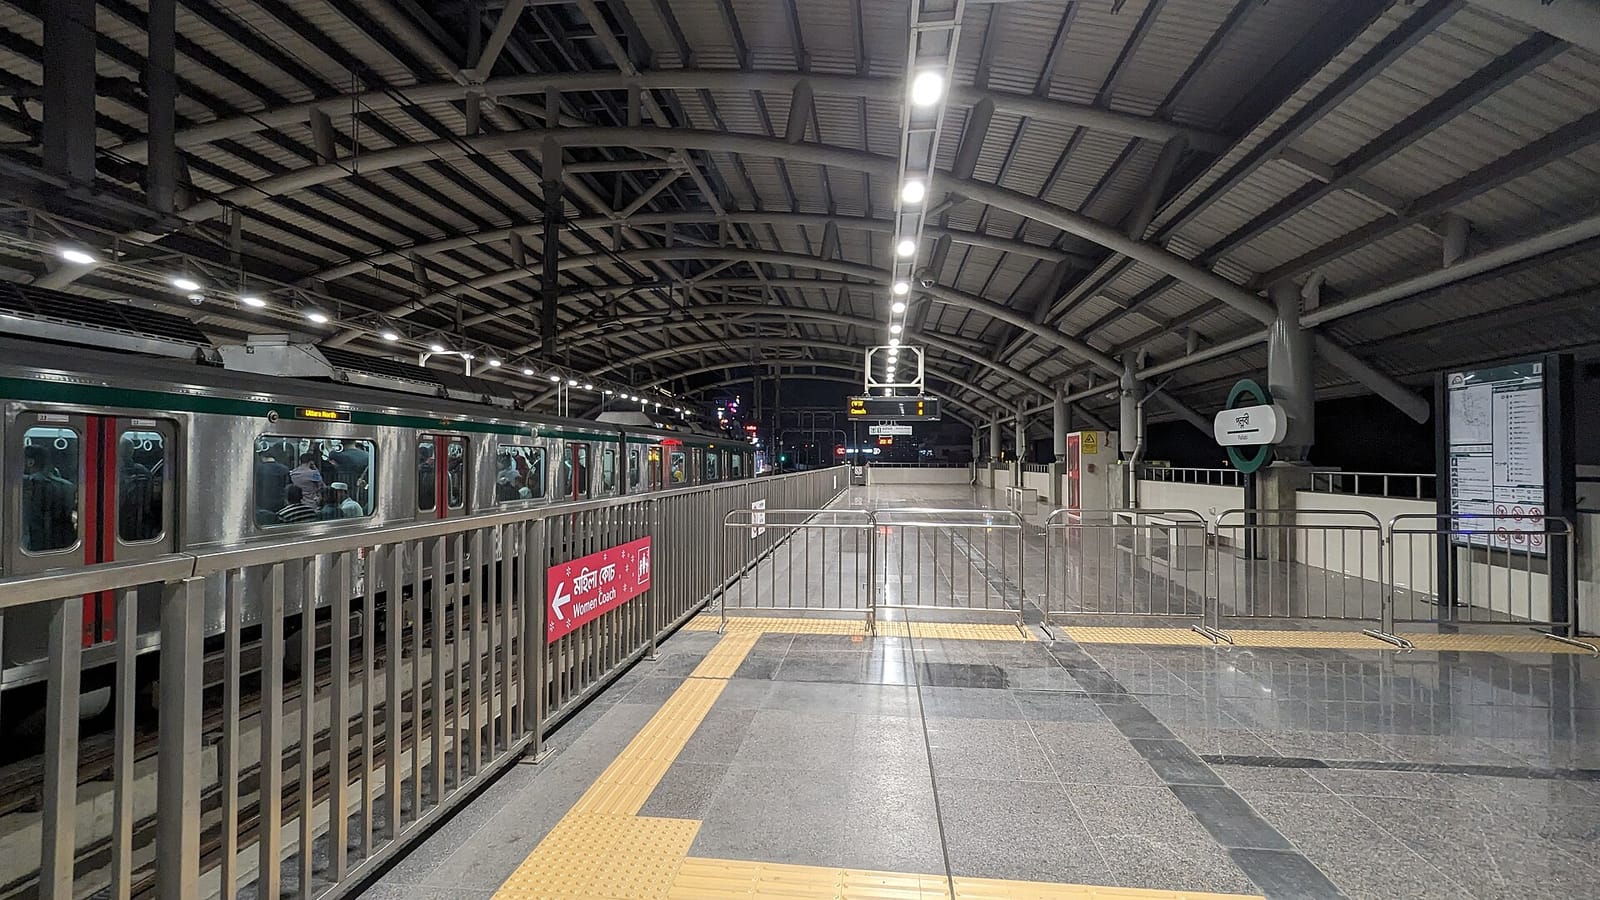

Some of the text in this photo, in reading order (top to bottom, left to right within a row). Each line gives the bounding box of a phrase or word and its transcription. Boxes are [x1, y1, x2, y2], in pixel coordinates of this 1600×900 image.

[573, 563, 616, 595] মহিলা কোচ
[573, 588, 616, 618] Women Coach
